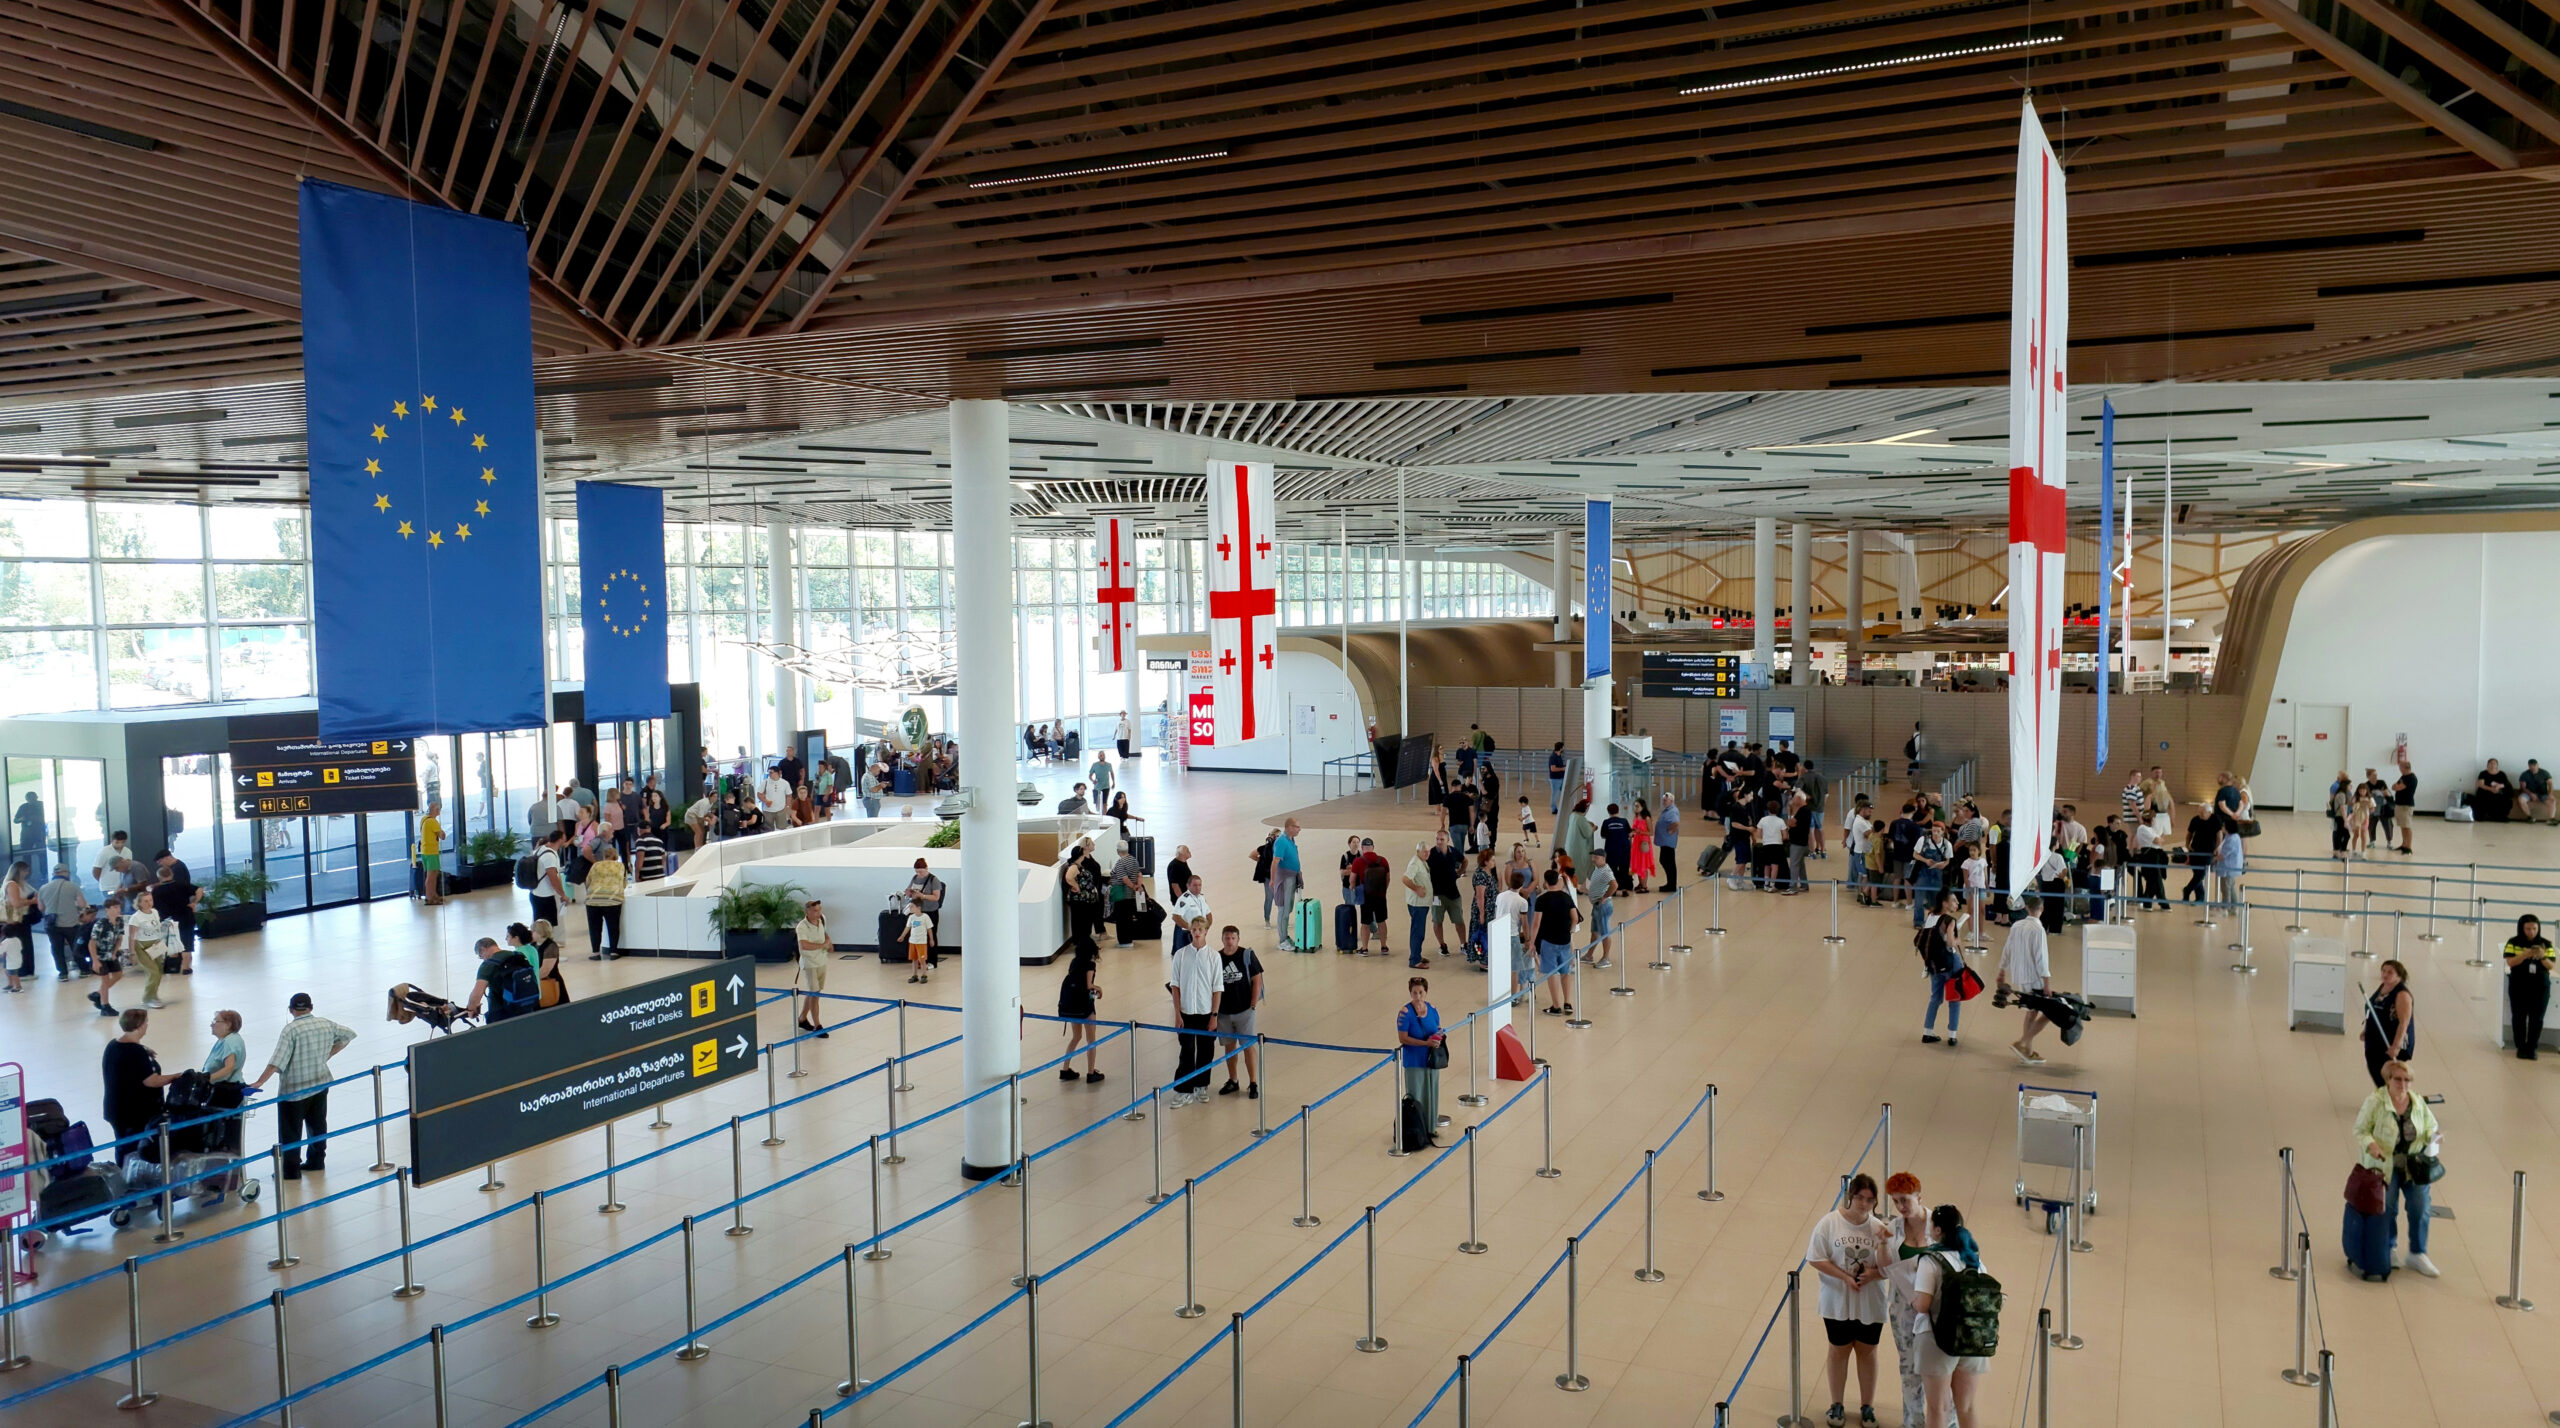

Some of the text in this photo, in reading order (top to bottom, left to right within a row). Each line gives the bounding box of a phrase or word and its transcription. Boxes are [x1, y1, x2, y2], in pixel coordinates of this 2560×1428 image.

[1193, 721, 1214, 737] SO
[600, 992, 683, 1024] ავიაბილეთები
[629, 1009, 684, 1032] Ticket Desks
[519, 1052, 686, 1113] საერთაშორისო გამგზავრება
[583, 1069, 686, 1111] International Departures
